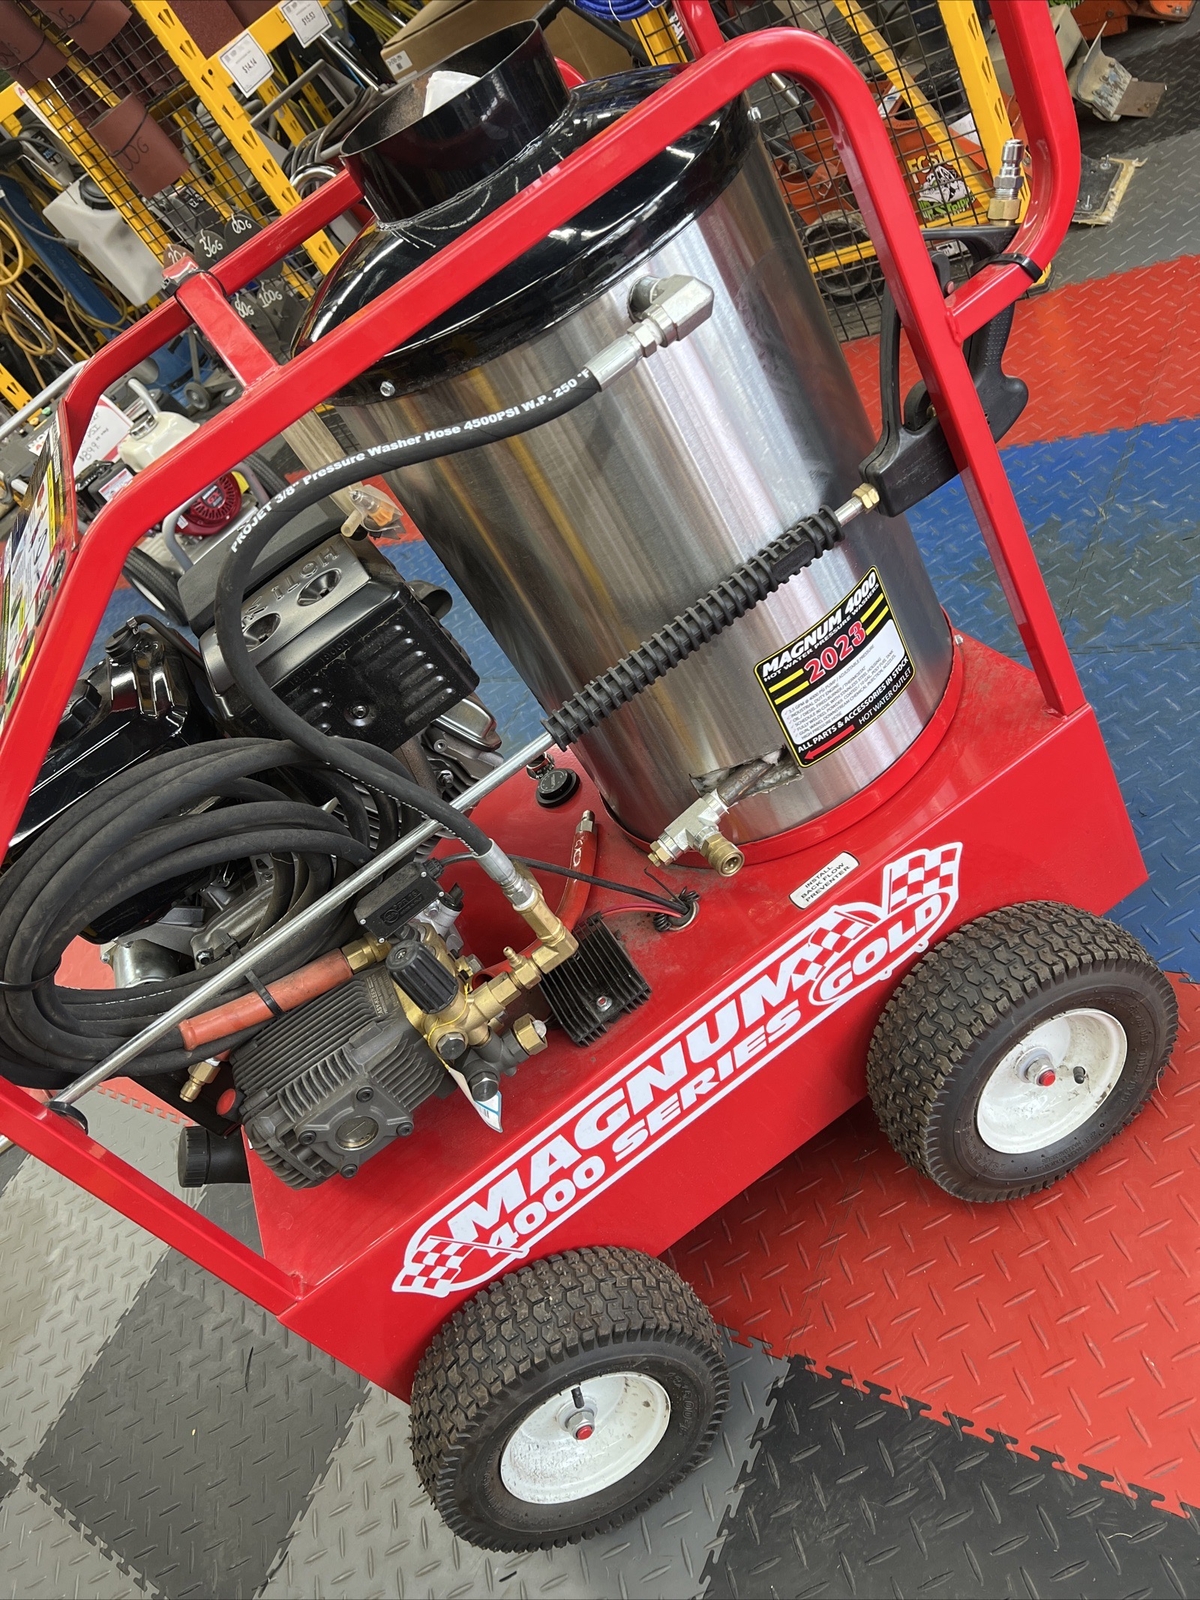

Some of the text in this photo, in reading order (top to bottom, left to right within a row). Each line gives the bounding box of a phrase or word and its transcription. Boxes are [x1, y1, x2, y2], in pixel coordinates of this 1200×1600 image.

[242, 58, 257, 74] $14.14
[259, 289, 283, 308] 100G
[231, 501, 272, 553] PROJET
[275, 481, 299, 504] 3/8"
[302, 452, 366, 486] Pressure
[367, 434, 422, 457] Washer
[424, 423, 461, 441] Hose
[463, 407, 521, 431] 4500PSI
[519, 394, 552, 414] W.P.
[552, 379, 578, 398] 250
[762, 571, 876, 678] MAGNUM 4000
[763, 583, 879, 682] HOT WATER PRESSURE WASHERS
[804, 620, 866, 684] 2023
[798, 657, 909, 753] ALL PARTS & ACCESSORIES IN STOCK
[858, 667, 912, 725] HOT WATER OUTLET
[801, 862, 844, 899] BACK FLOW
[805, 866, 833, 888] INSTALL
[805, 866, 850, 902] PREVENTER
[447, 894, 942, 1243] MAGNUM GOLD
[487, 999, 801, 1258] 4000 SERIES
